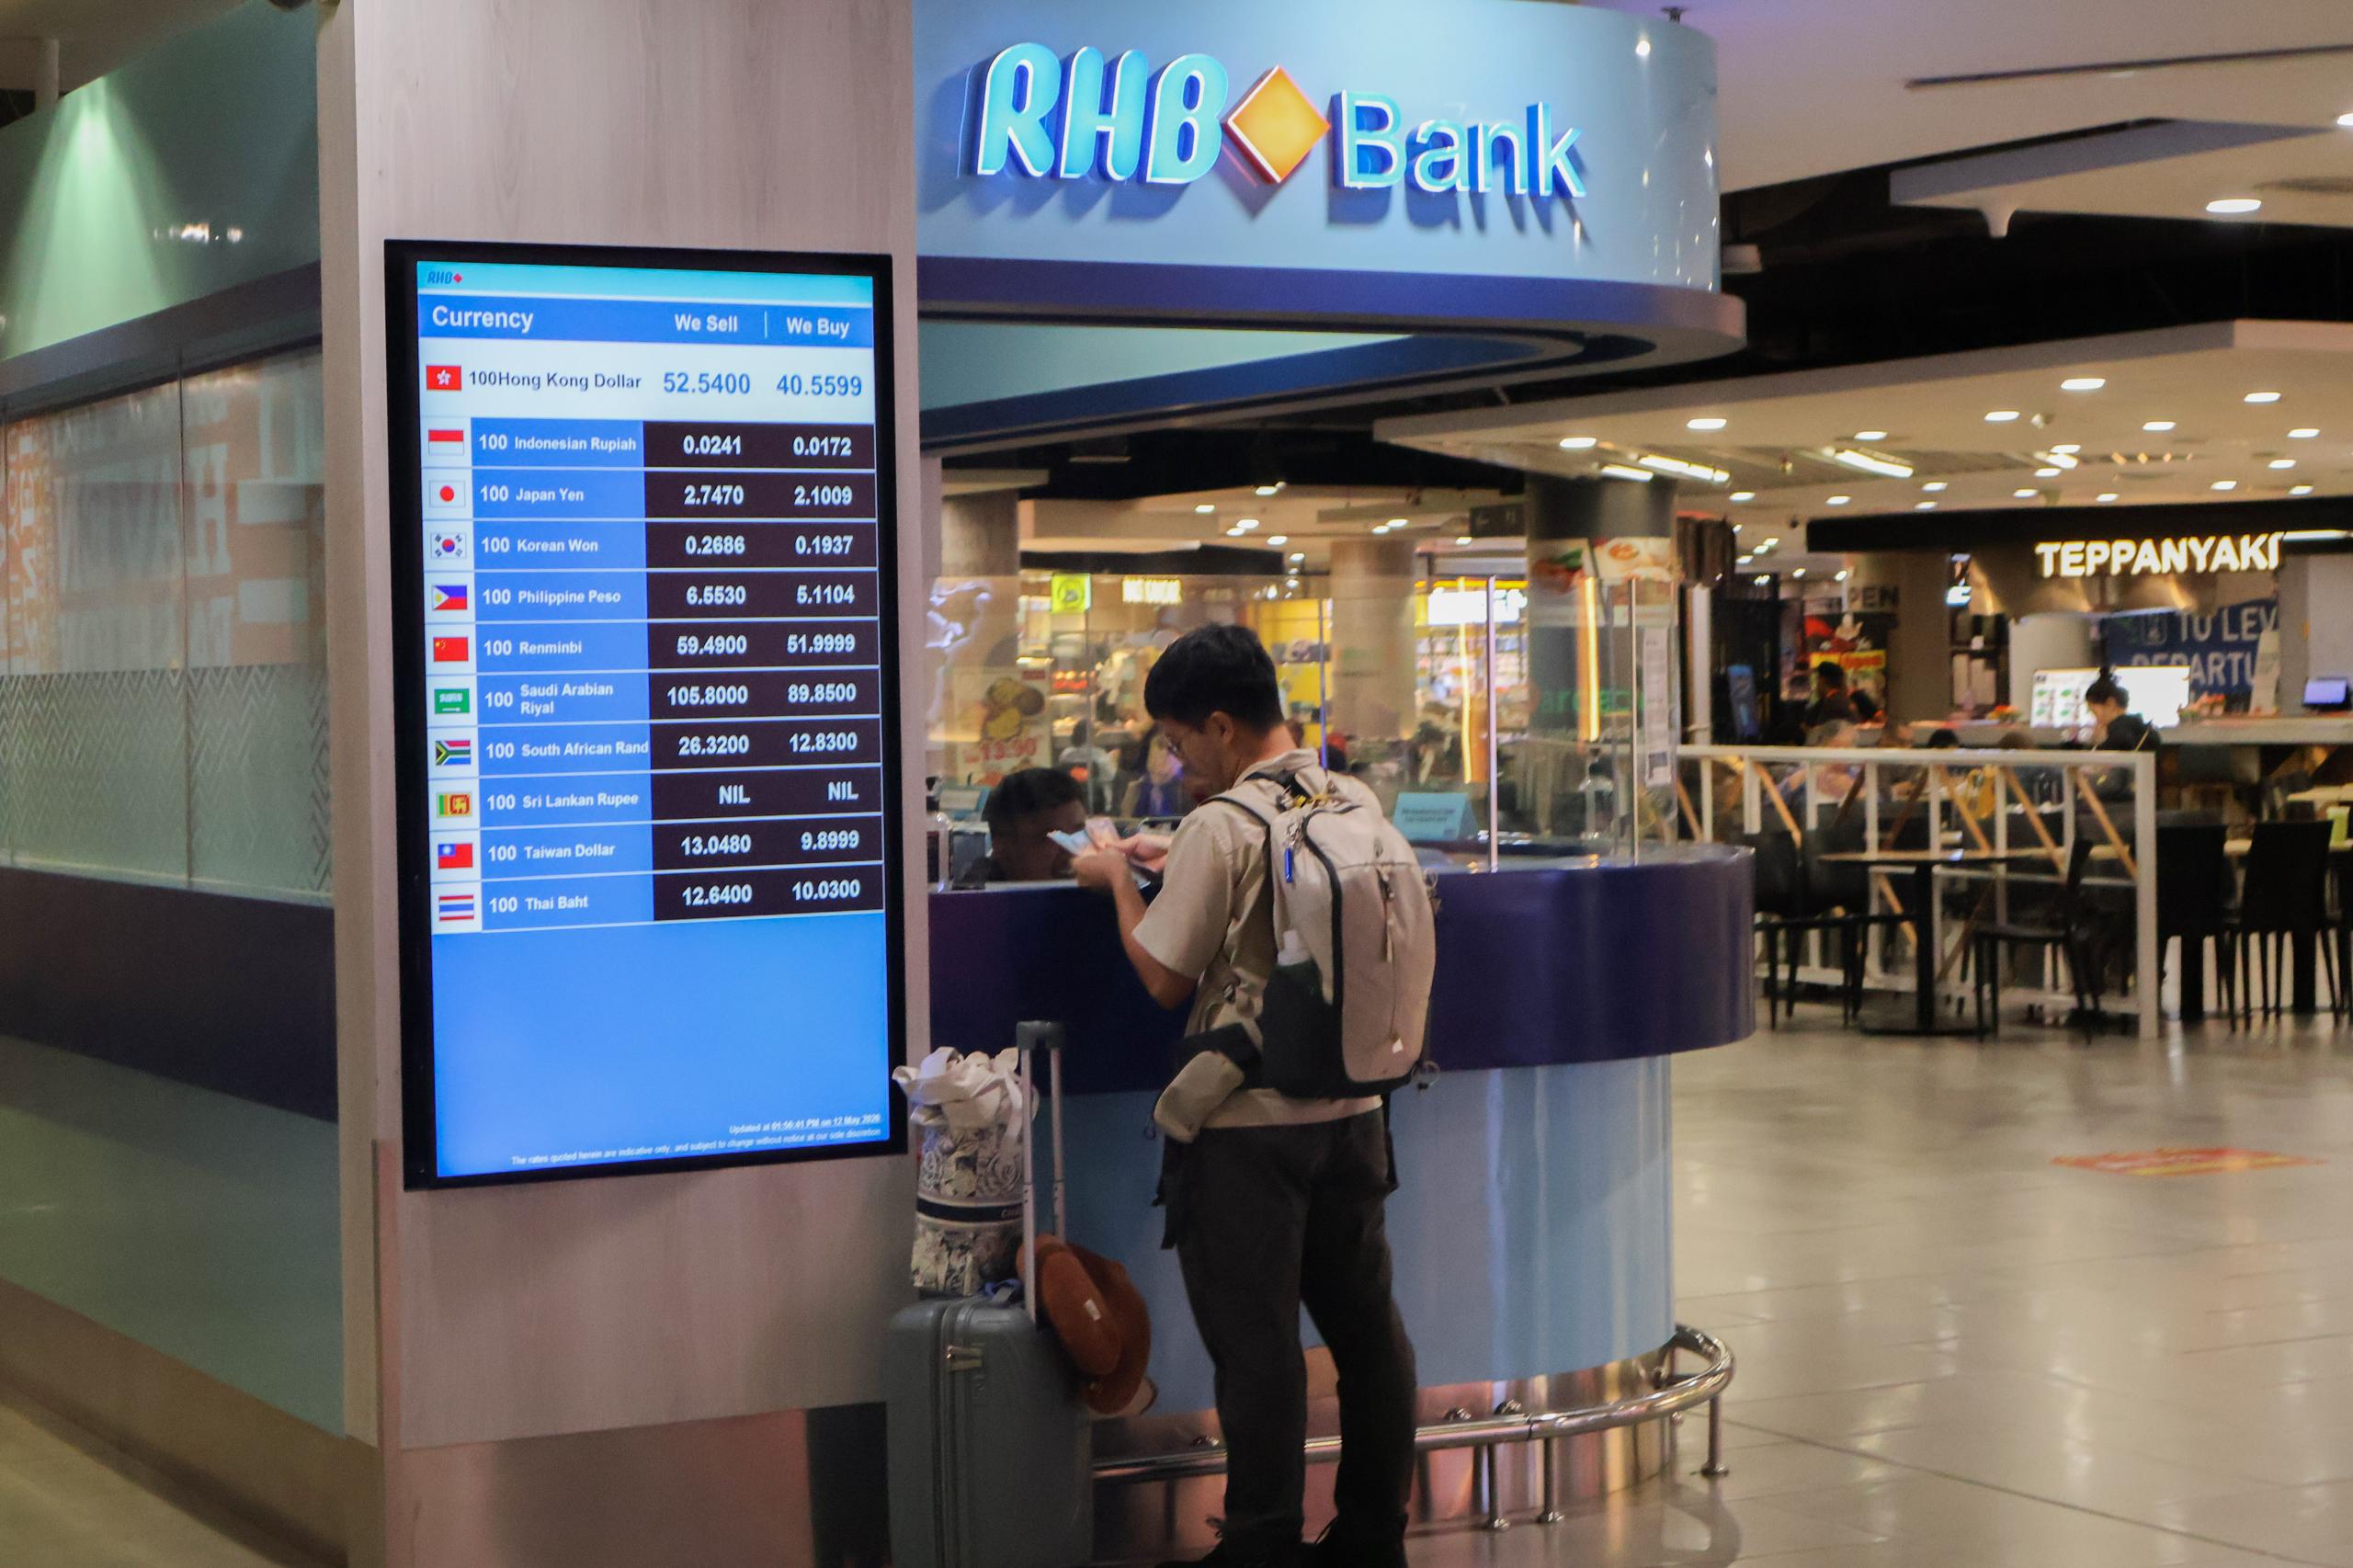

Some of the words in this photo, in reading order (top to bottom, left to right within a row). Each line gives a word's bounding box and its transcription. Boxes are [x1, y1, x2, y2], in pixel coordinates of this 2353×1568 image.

[976, 41, 1229, 185] RHB
[1332, 89, 1586, 199] Bank
[427, 270, 453, 285] RHB
[432, 305, 533, 334] Currency
[675, 313, 701, 332] We
[706, 314, 738, 333] Sell
[786, 316, 813, 335] We
[817, 317, 850, 340] Buy
[547, 371, 588, 392] Kong
[595, 373, 642, 389] Dollar
[663, 371, 751, 394] 52.5400
[776, 374, 862, 397] 40.5599
[479, 434, 507, 450] 100
[515, 436, 587, 450] Indonesian
[591, 436, 637, 453] Rupiah
[683, 435, 742, 456] 0.0241
[792, 436, 853, 457] 0.0172
[480, 484, 509, 503] 100
[516, 487, 556, 505] Japan
[559, 487, 585, 502] Yen
[683, 484, 745, 506] 2.7470
[793, 484, 853, 506] 2.1009
[481, 536, 510, 553] 100
[517, 539, 565, 552] Korean
[568, 539, 598, 552] Won
[685, 535, 746, 555] 0.2686
[795, 534, 854, 555] 0.1937
[2034, 531, 2285, 579] TEPPANYAKI
[483, 588, 511, 606] 100
[517, 589, 585, 607] Philippine
[588, 589, 622, 604] Peso
[686, 585, 747, 606] 6.5530
[796, 584, 856, 605] 5.1104
[483, 640, 513, 657] 100
[519, 641, 583, 655] Renminbi
[676, 635, 748, 655] 59.4900
[786, 633, 857, 654] 51.9999
[485, 691, 514, 709] 100
[520, 683, 559, 698] Saudi
[562, 682, 614, 697] Arabian
[666, 684, 749, 707] 105.8000
[788, 682, 858, 704] 89.8500
[520, 701, 554, 718] Riyal
[486, 742, 515, 759] 100
[521, 742, 561, 757] South
[564, 741, 612, 756] African
[616, 740, 649, 755] Rand
[678, 733, 751, 756] 26.3200
[789, 731, 858, 753] 12.8300
[718, 784, 752, 805] NIL
[827, 780, 859, 801] NIL
[487, 793, 516, 811] 100
[522, 794, 542, 809] Sri
[546, 793, 595, 808] Lankan
[597, 792, 640, 809] Rupee
[680, 833, 753, 857] 13.0480
[800, 829, 861, 851] 9.8999
[488, 845, 517, 862] 100
[524, 846, 572, 859] Taiwan
[575, 843, 616, 858] Dollar
[681, 883, 754, 906] 12.6400
[791, 878, 861, 901] 10.0300
[489, 896, 518, 914] 100
[525, 896, 554, 912] Thai
[557, 894, 589, 910] Baht
[511, 1155, 527, 1165] The
[528, 1154, 549, 1165] rates
[551, 1152, 577, 1164] quoted
[604, 1150, 617, 1159] are
[675, 1142, 688, 1153] and
[690, 1140, 717, 1153] subject
[718, 1139, 727, 1149] to
